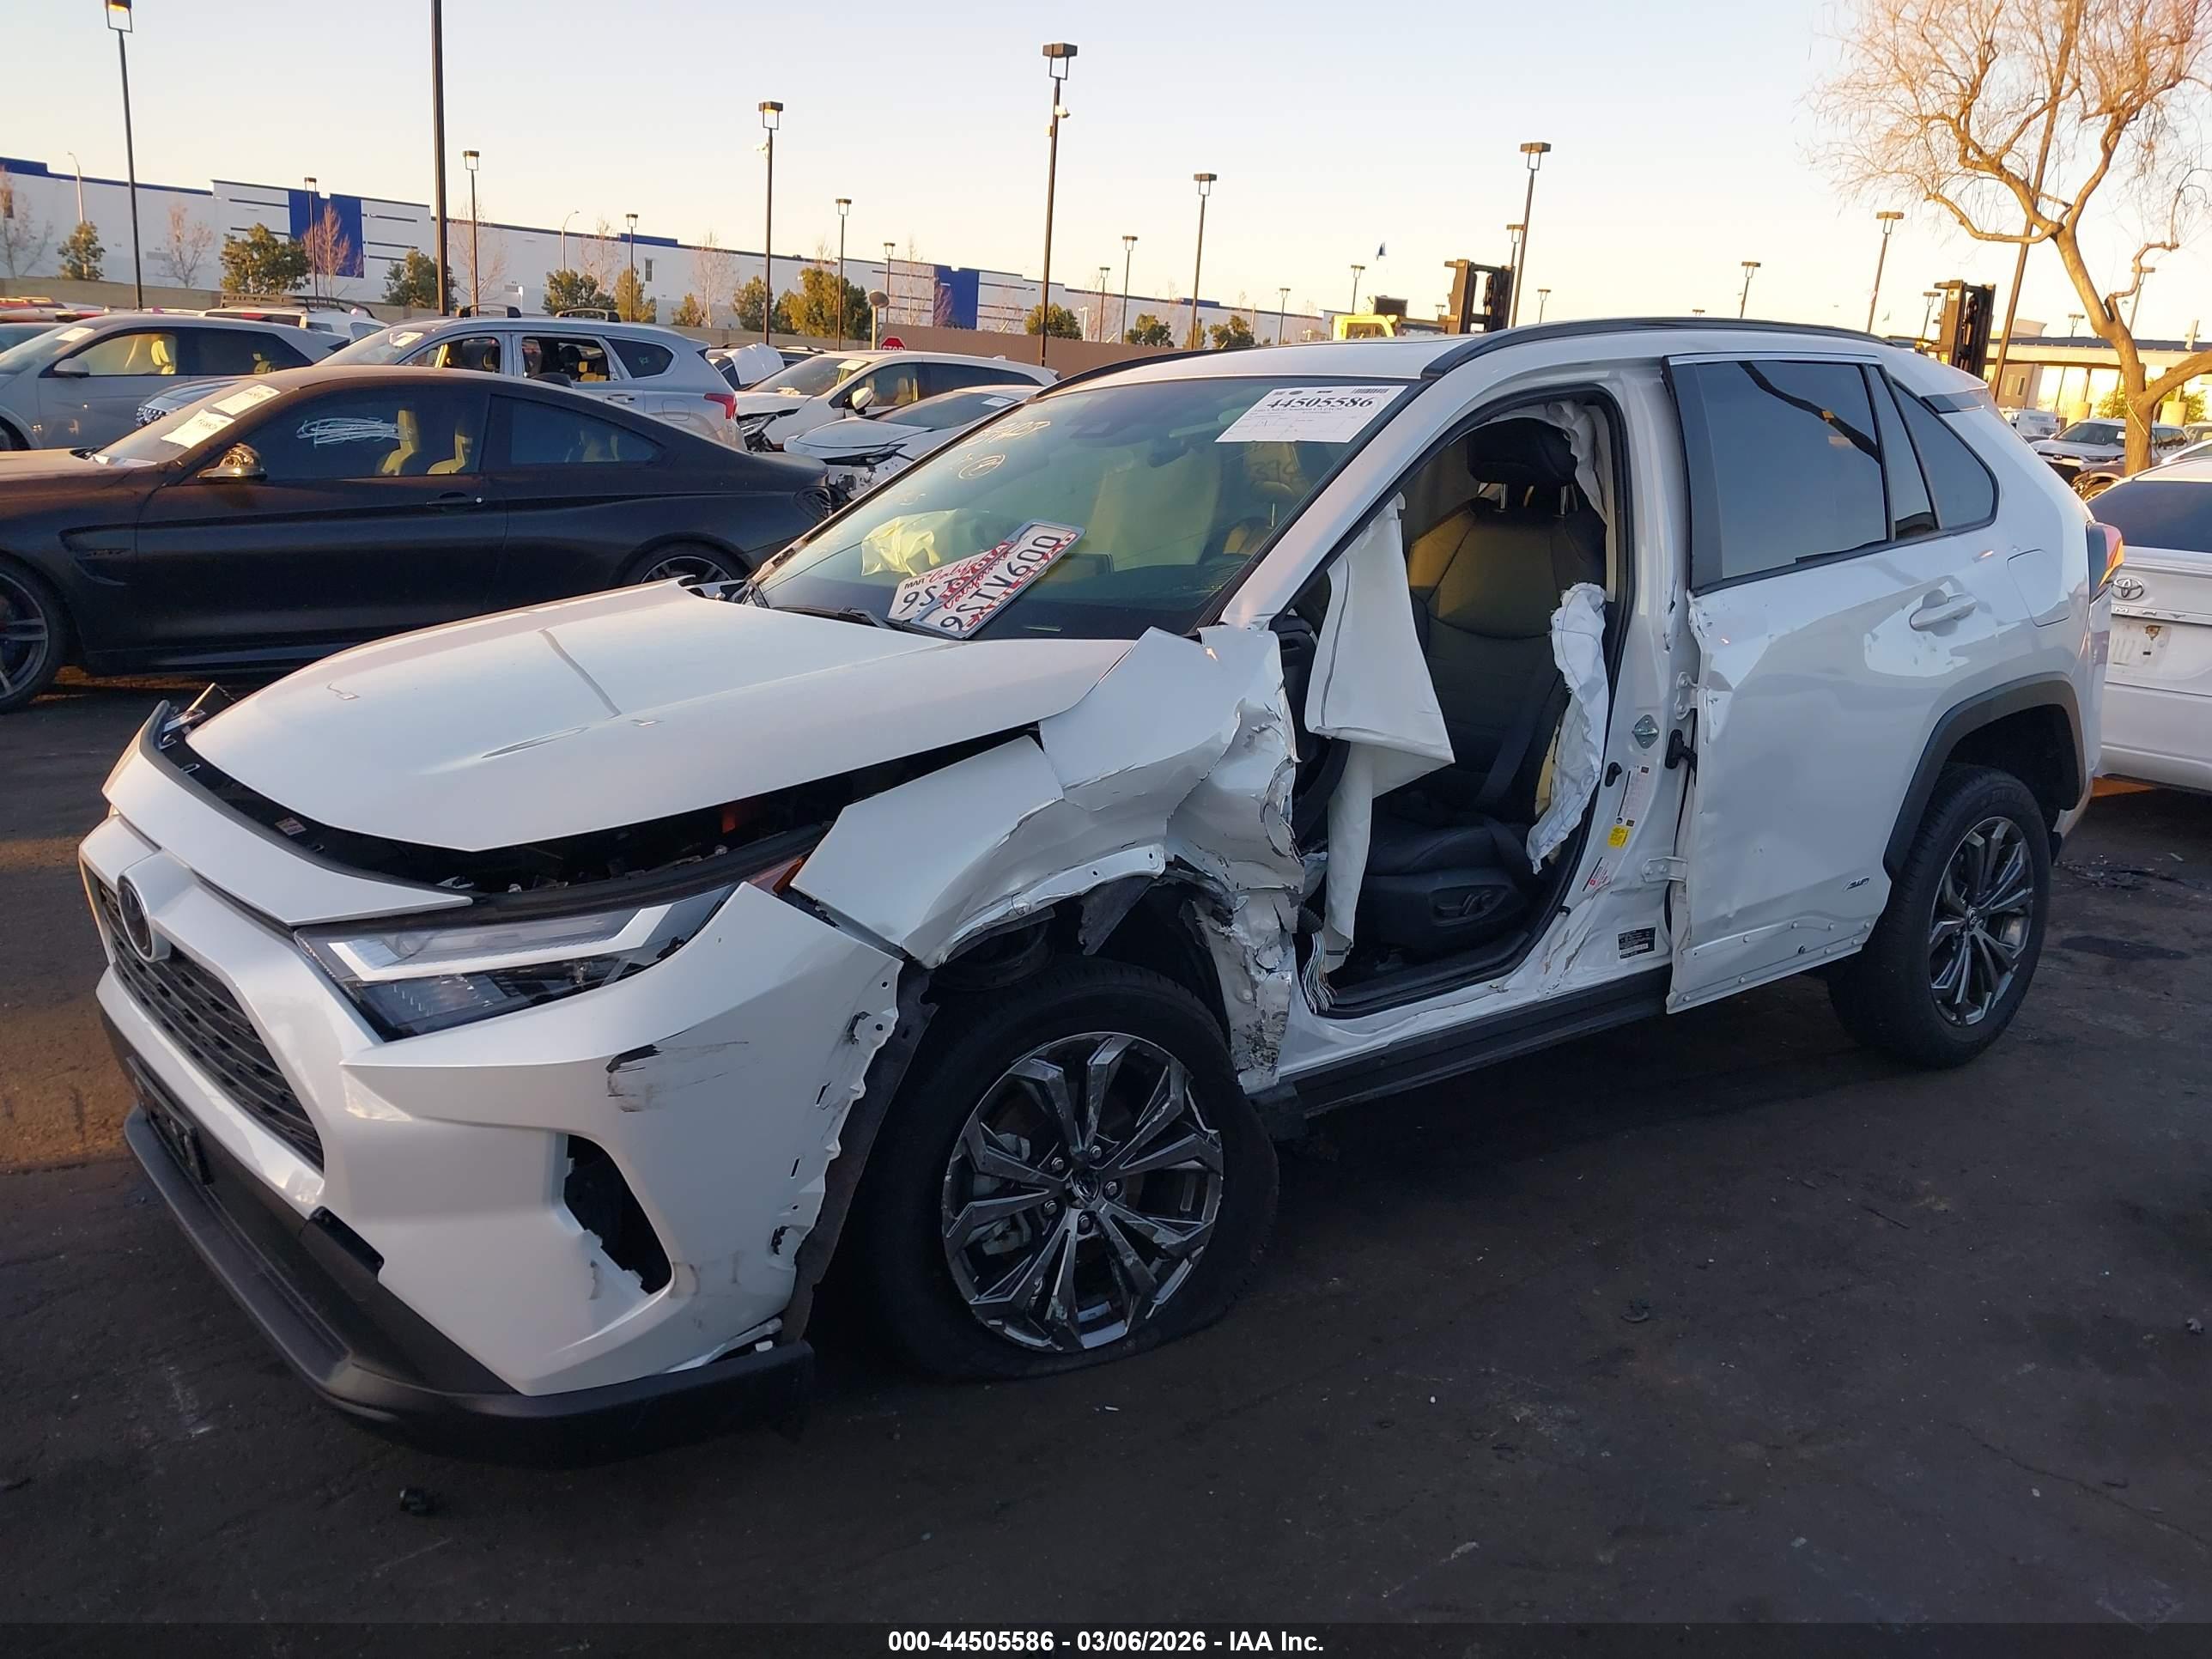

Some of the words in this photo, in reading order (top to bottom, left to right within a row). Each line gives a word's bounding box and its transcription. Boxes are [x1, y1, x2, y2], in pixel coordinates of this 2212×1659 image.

[1267, 397, 1376, 408] 44505586
[940, 535, 1062, 631] 9STV600
[943, 544, 1009, 597] TOYOTA
[944, 546, 1017, 609] California
[963, 533, 1077, 632] CARLSBAD
